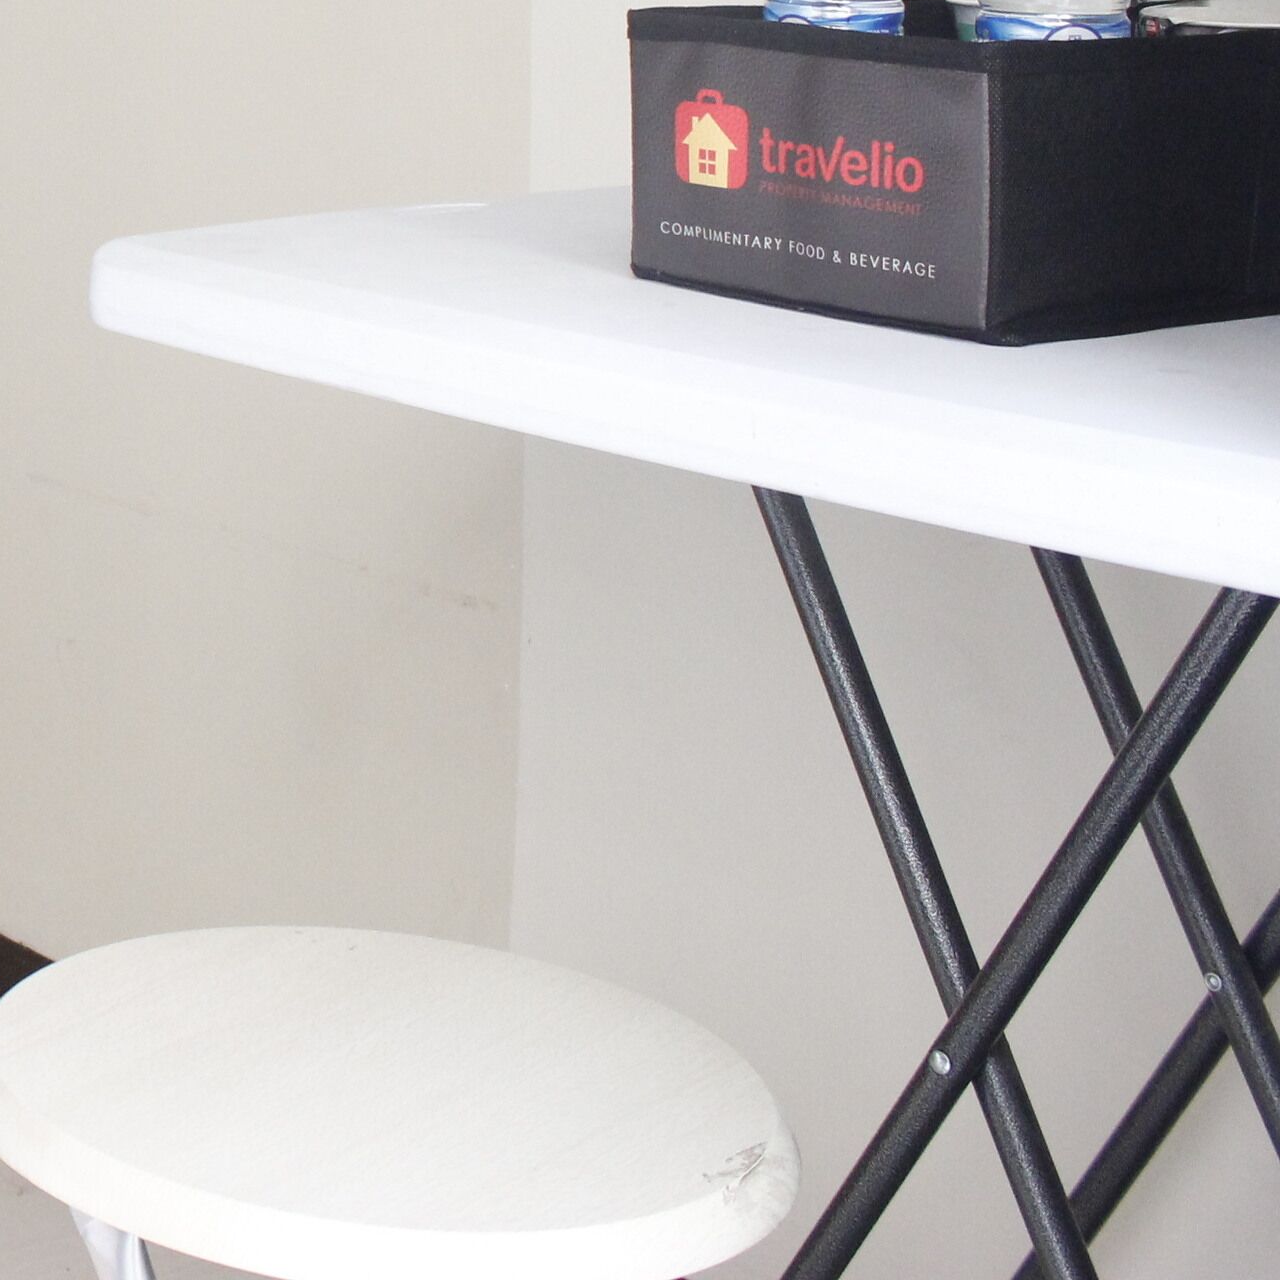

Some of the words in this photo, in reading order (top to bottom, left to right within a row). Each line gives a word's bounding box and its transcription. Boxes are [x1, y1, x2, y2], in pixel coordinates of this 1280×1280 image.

[759, 127, 925, 193] travelio
[659, 221, 782, 251] COMPLIMENTARY
[789, 240, 826, 261] FOOD
[832, 249, 842, 263] &
[849, 251, 937, 280] BEVERAGE
